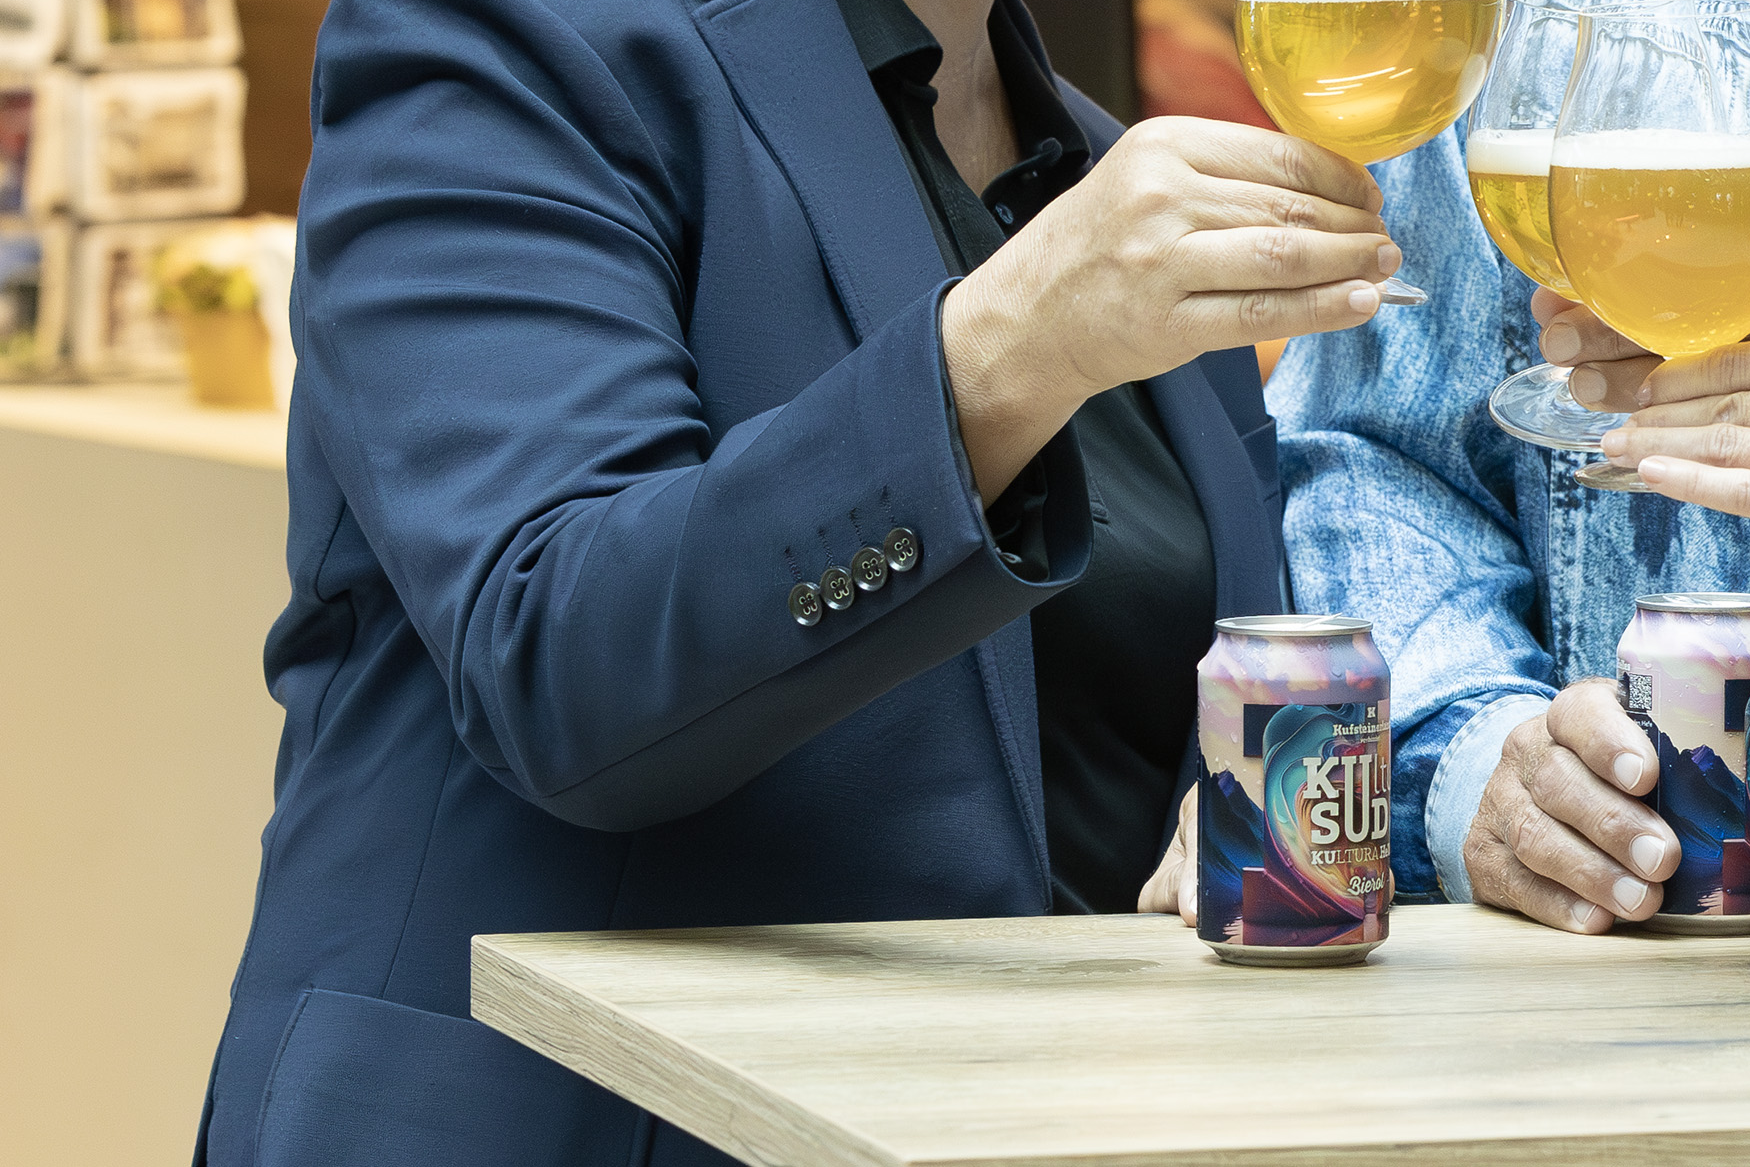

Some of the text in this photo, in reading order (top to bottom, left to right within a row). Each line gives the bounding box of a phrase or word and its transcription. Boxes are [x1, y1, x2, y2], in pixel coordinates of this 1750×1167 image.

[1311, 797, 1388, 844] SUD
[1311, 847, 1379, 865] KULTURA
[1347, 873, 1385, 895] Bierol
